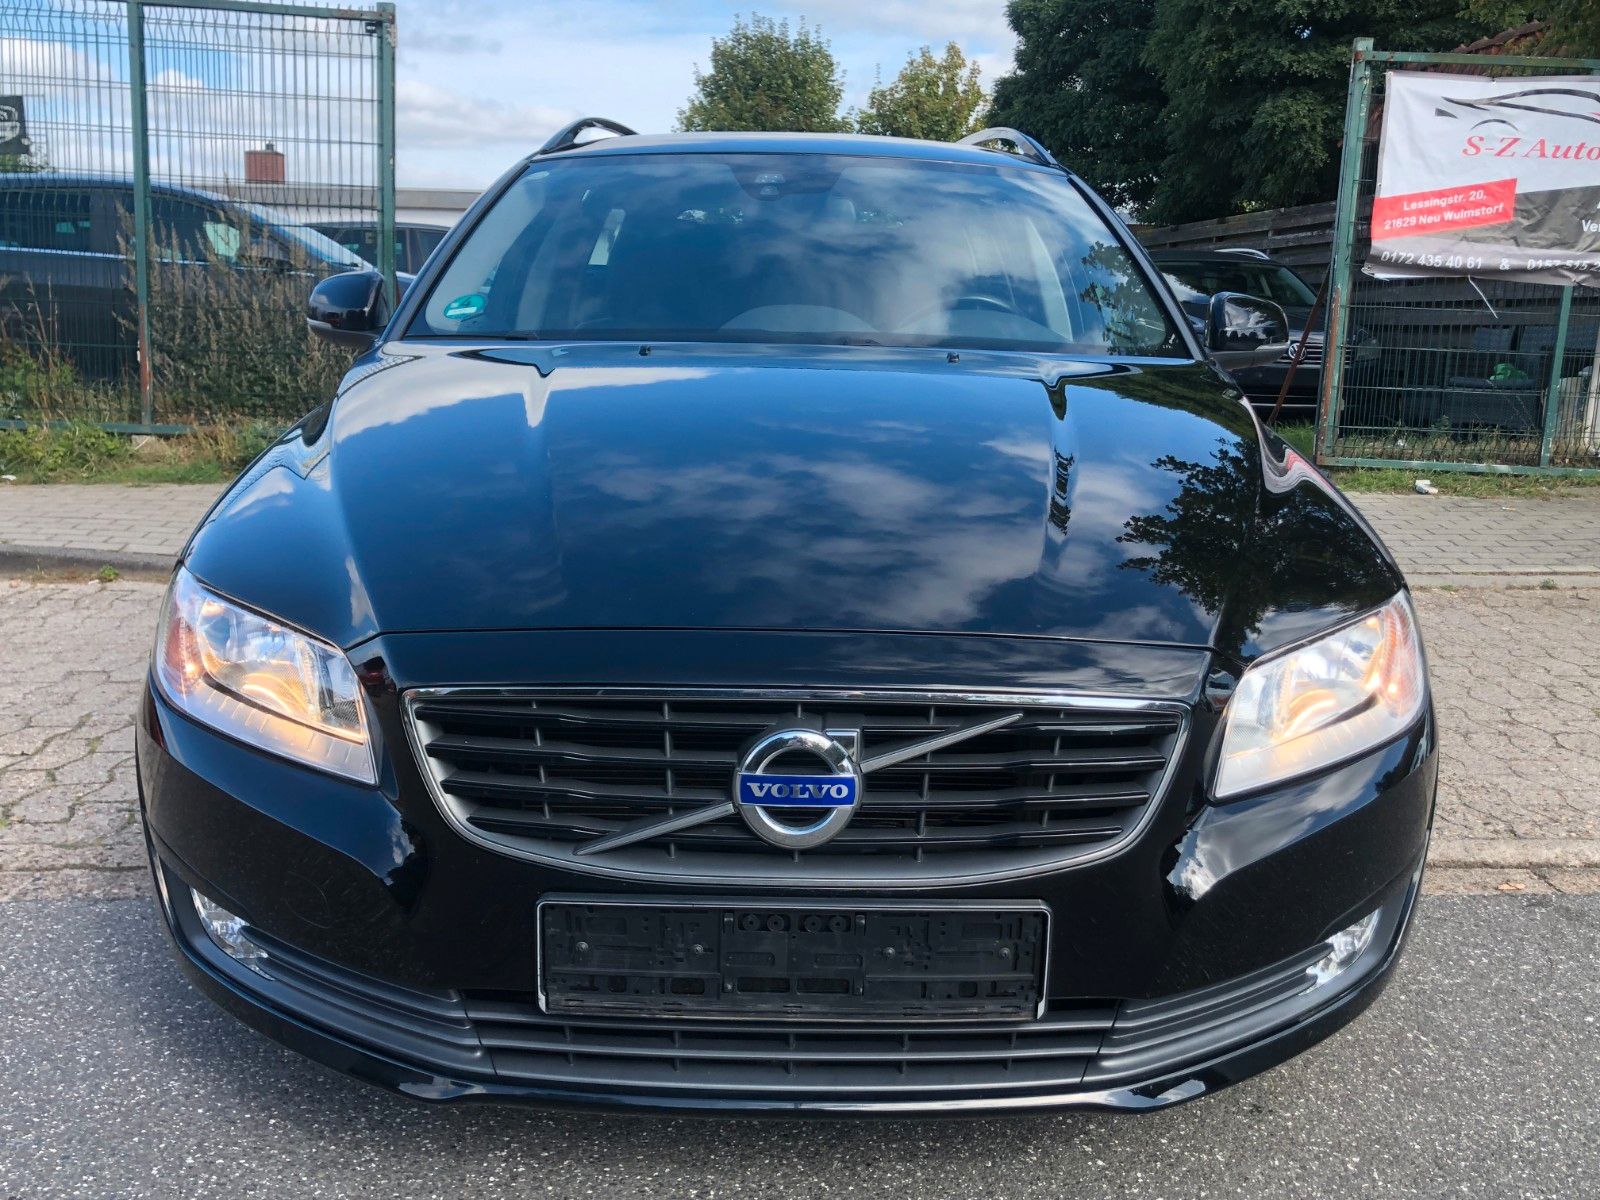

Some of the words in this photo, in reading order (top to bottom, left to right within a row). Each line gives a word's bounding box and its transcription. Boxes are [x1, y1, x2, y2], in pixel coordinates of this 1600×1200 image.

[1462, 135, 1521, 157] S-Z
[1403, 195, 1467, 211] Lessingstr.
[1419, 214, 1441, 225] Neu
[1443, 203, 1504, 221] Wulmstorf
[1380, 251, 1415, 265] 0172
[1416, 254, 1442, 268] 435
[1445, 256, 1462, 269] 40
[1466, 257, 1482, 270] 61
[1499, 258, 1511, 271] &
[747, 783, 849, 799] VOLVO
